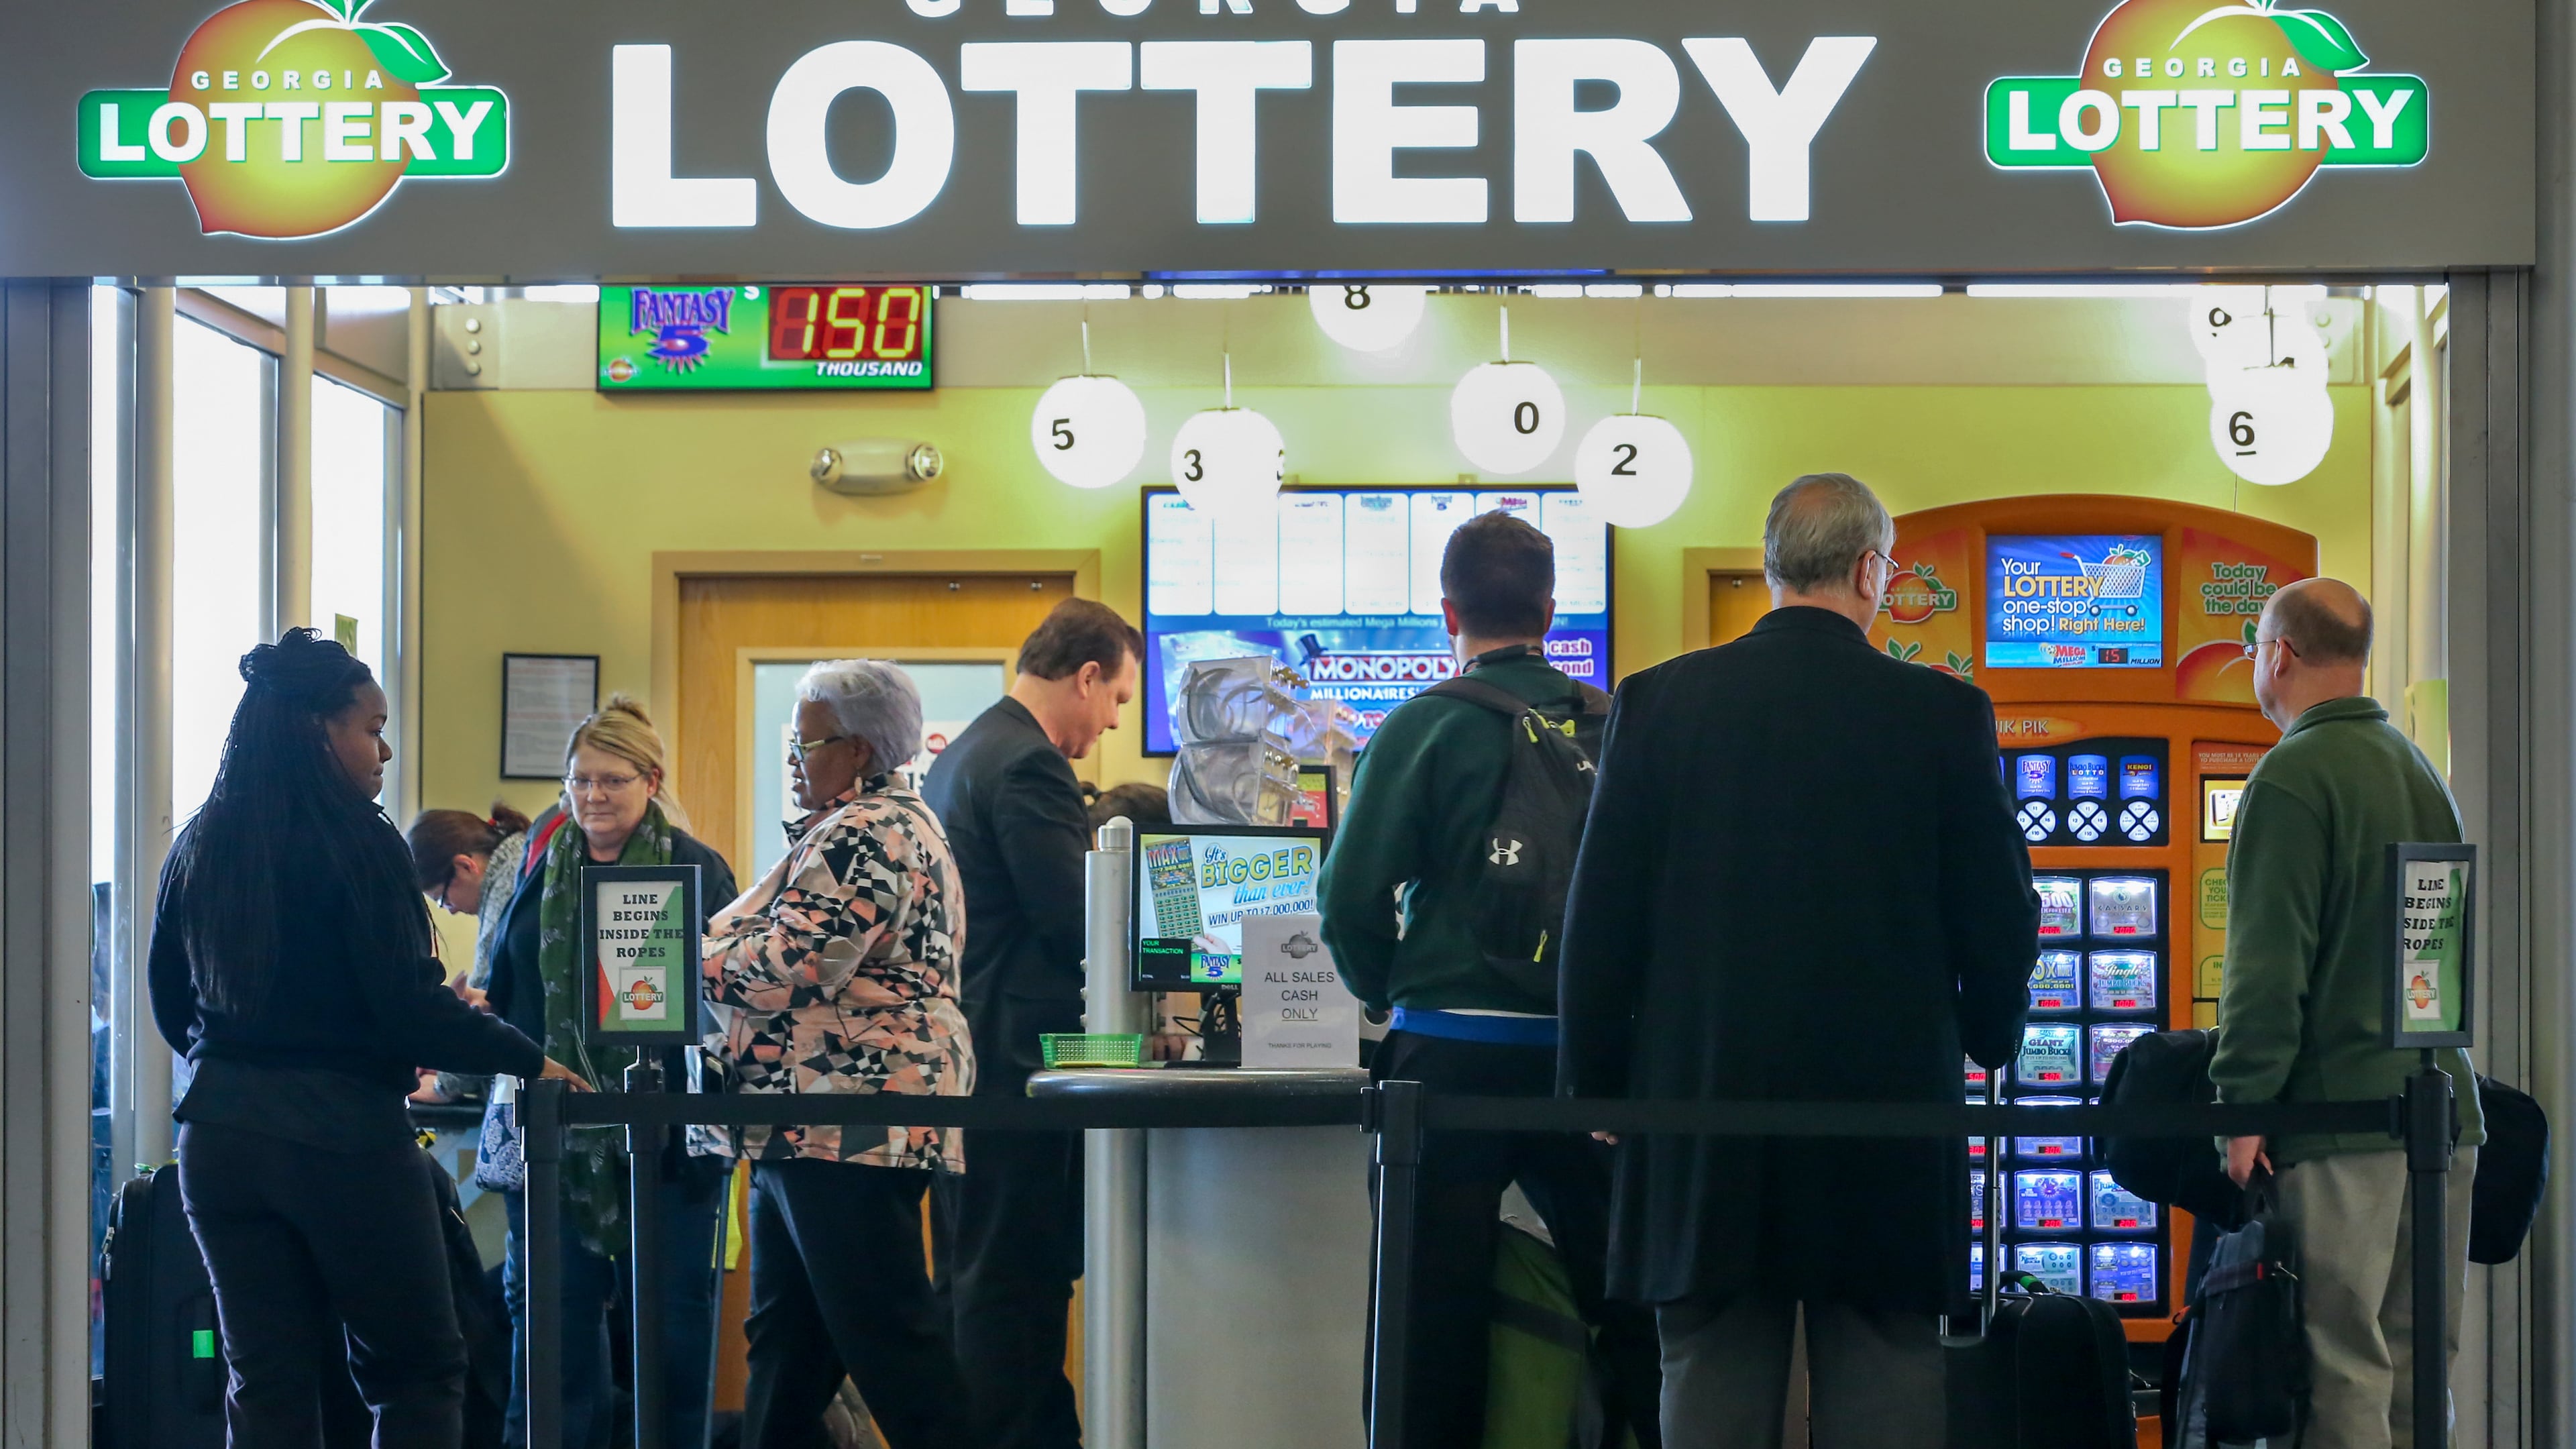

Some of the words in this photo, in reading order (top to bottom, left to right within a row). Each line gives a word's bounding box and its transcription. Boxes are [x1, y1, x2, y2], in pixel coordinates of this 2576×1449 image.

[2102, 57, 2302, 78] GEORGIA
[191, 69, 384, 90] GEORGIA
[2008, 88, 2415, 152] LOTTERY
[99, 101, 494, 163] LOTTERY
[612, 36, 1878, 229] LOTTERY
[631, 288, 735, 335] FANTASY
[802, 288, 921, 358] 150
[647, 325, 710, 358] 5
[816, 362, 923, 376] THOUSAND
[1513, 401, 1540, 435] 0
[1051, 417, 1075, 451] 5
[2228, 411, 2256, 447] 6
[1183, 449, 1204, 482] 3
[1611, 443, 1638, 476] 2
[2001, 558, 2041, 576] Your
[2212, 564, 2267, 582] Today
[2004, 576, 2104, 597] LOTTERY
[2201, 581, 2250, 596] could
[2253, 581, 2277, 596] be
[1882, 593, 1951, 606] OTTERY
[2002, 597, 2088, 617] one-stop
[2205, 598, 2232, 613] the
[1267, 618, 1308, 629] Today's
[1310, 618, 1361, 628] estimated
[1365, 618, 1396, 630] Mega
[1398, 617, 1439, 628] Millions
[2002, 615, 2055, 635] shop!
[2059, 617, 2099, 634] Right
[2103, 617, 2145, 631] Here!
[1550, 639, 1591, 653] cash
[2055, 645, 2086, 657] MEGA
[2053, 656, 2086, 664] MILLIONS
[2105, 649, 2121, 663] 15
[1311, 657, 1458, 681] MONOPOLY
[2022, 720, 2049, 734] PIK
[2023, 761, 2051, 773] FANTASY
[1148, 846, 1179, 868] MAX
[1205, 843, 1227, 863] It's
[1201, 846, 1313, 888] BIGGER
[1233, 883, 1267, 905] than
[1272, 871, 1314, 898] ever!
[623, 894, 658, 905] LINE
[2404, 896, 2452, 910] BEGINS
[613, 910, 669, 921] BEGINS
[1209, 913, 1228, 926] WIN
[1230, 910, 1242, 922] UP
[599, 929, 649, 939] INSIDE
[653, 928, 684, 939] THE
[2404, 938, 2444, 951] ROPES
[616, 947, 666, 958] ROPES
[1200, 955, 1231, 969] FANTASY
[1205, 967, 1224, 977] 5
[1265, 972, 1288, 983] ALL
[1292, 971, 1335, 983] SALES
[2102, 963, 2140, 977] Jingle
[624, 991, 663, 1002] LOTTERY
[1281, 989, 1318, 1001] CASH
[2407, 989, 2436, 1000] LOTTERY
[1282, 1008, 1318, 1020] ONLY
[2028, 1038, 2064, 1046] GIANT
[2021, 1046, 2047, 1057] JUMBO
